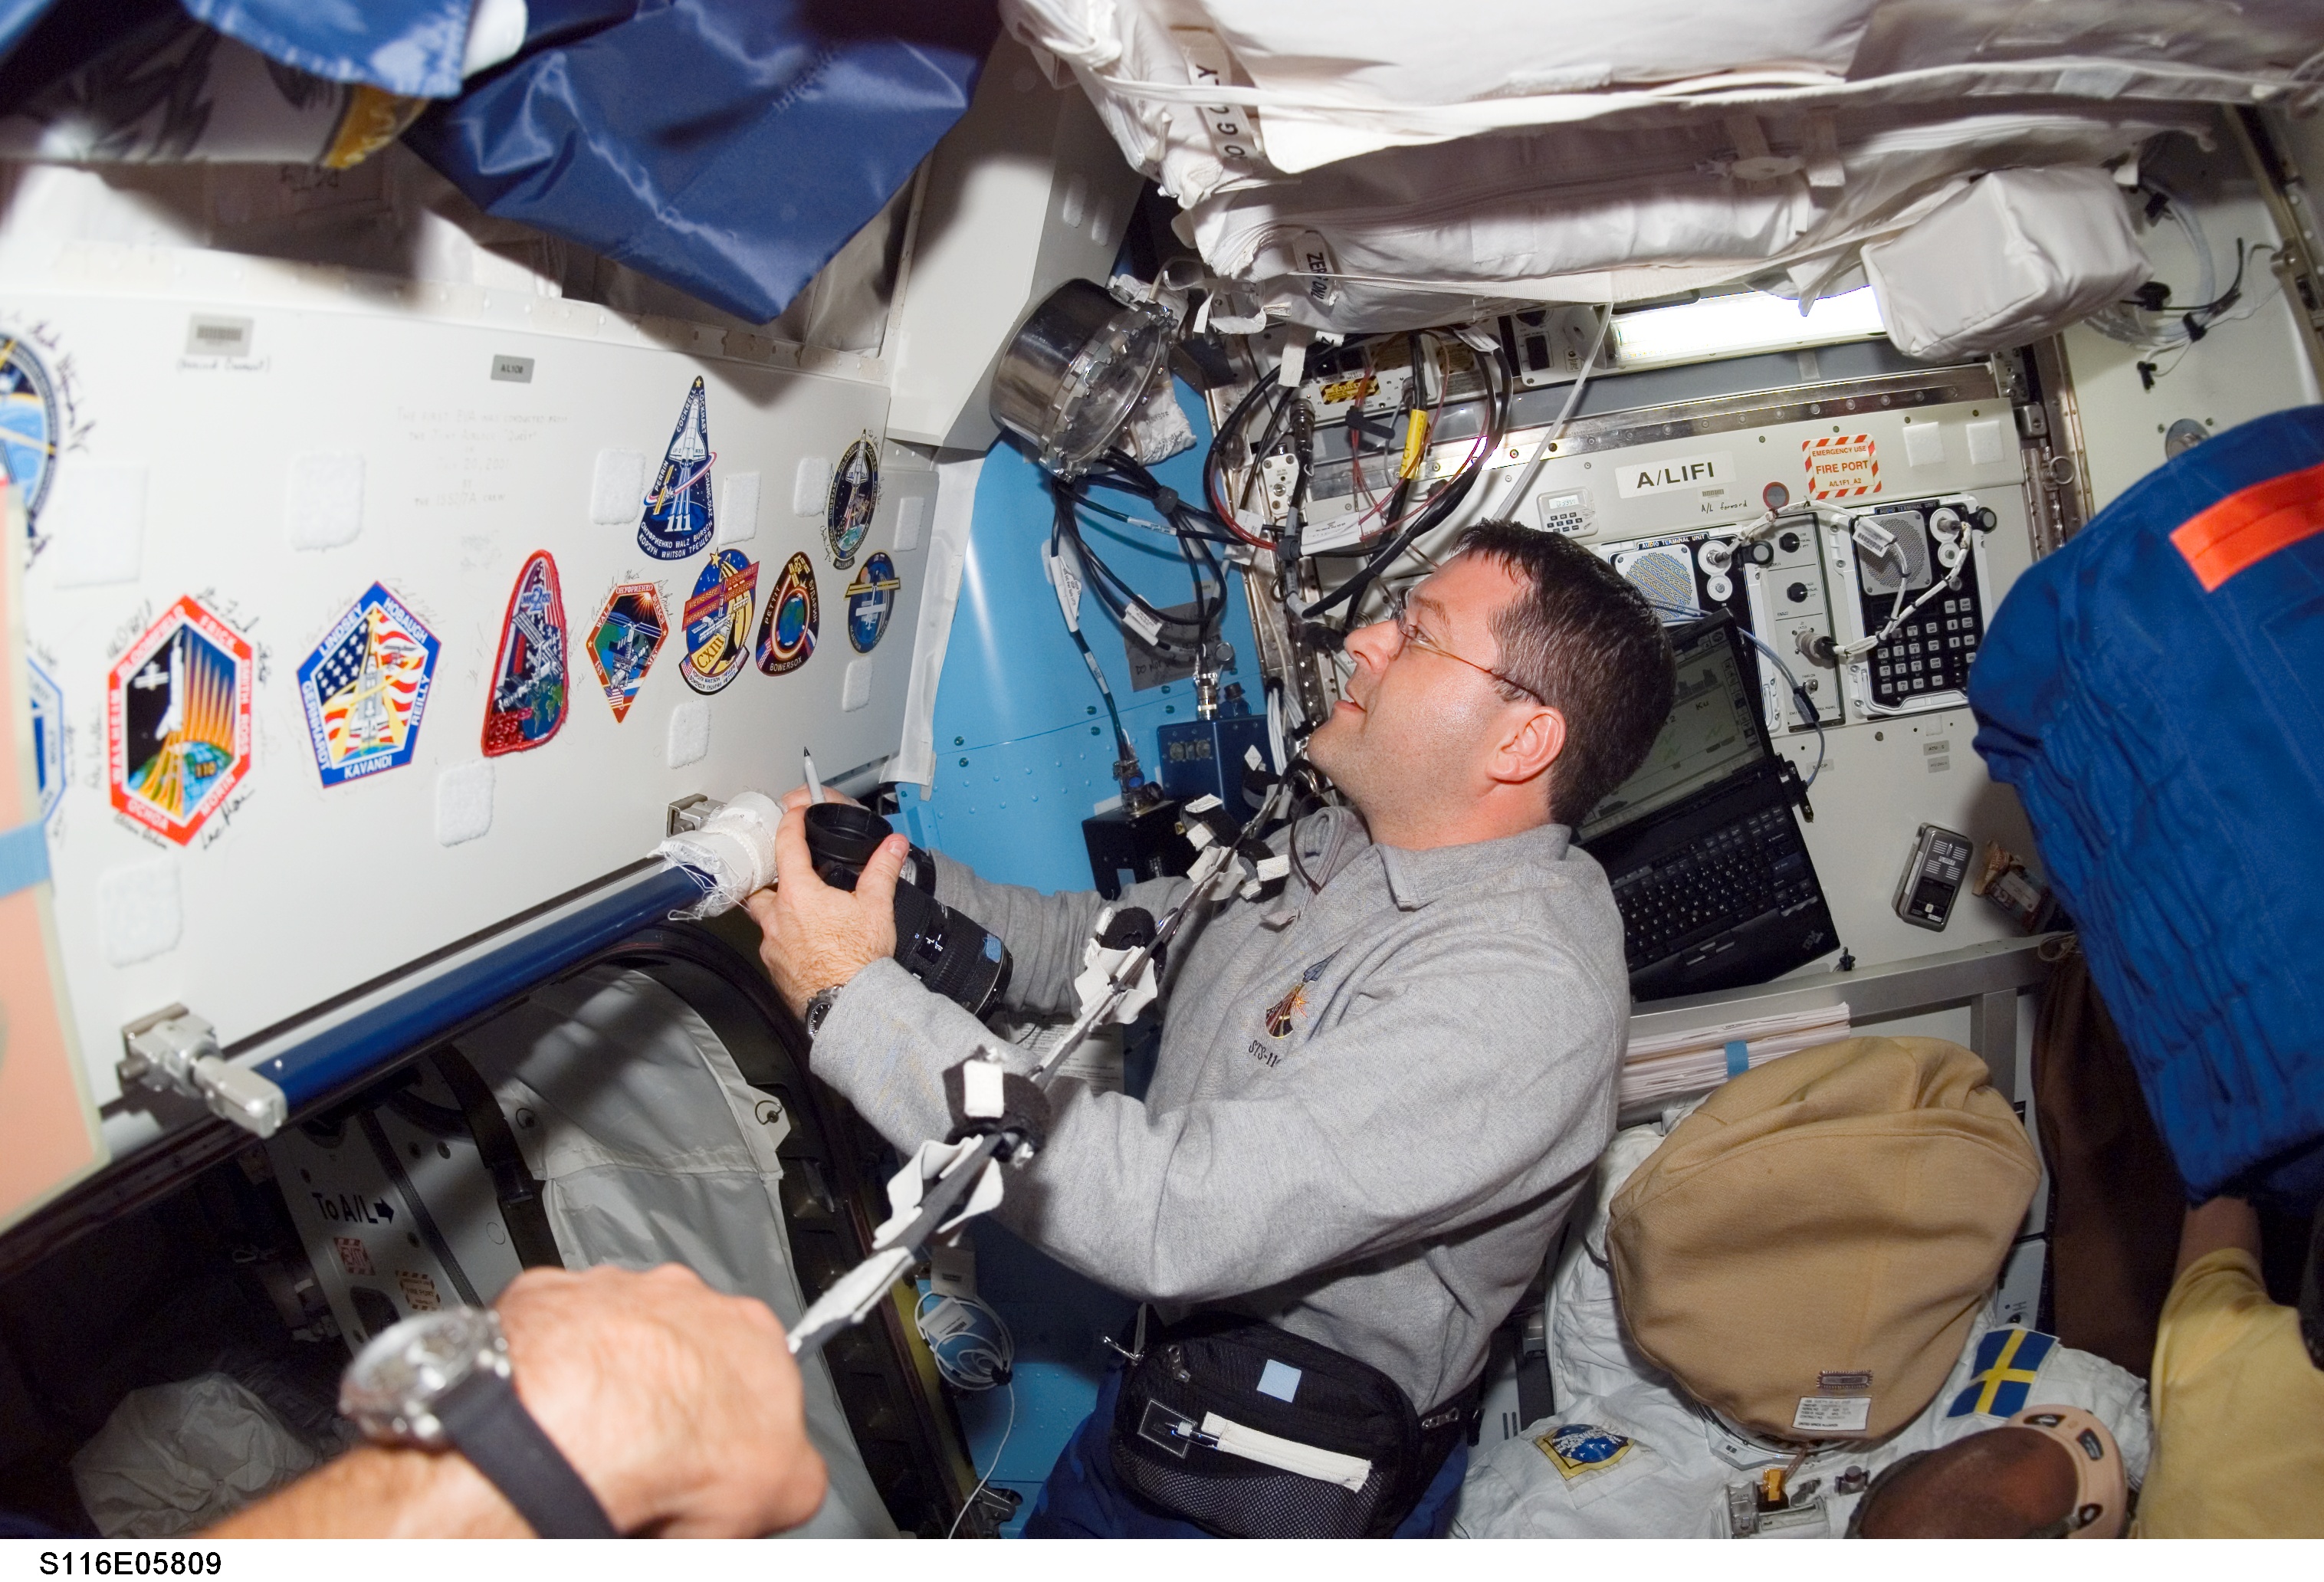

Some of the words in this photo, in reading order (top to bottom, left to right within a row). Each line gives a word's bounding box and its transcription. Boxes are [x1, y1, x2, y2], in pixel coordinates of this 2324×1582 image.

[676, 389, 696, 432] COCKRELL
[1811, 447, 1853, 458] EMERGENCY
[1815, 463, 1840, 474] FIRE
[1841, 460, 1869, 471] PORT
[655, 461, 669, 492] PERRIN
[665, 514, 691, 533] 111
[675, 538, 690, 548] WALZ
[693, 522, 713, 542] BURSCH
[661, 550, 686, 559] WHITSON
[1642, 540, 1659, 549] AUDIO
[1661, 537, 1689, 545] TERMINAL
[383, 597, 428, 644] HOBAUGH
[596, 603, 612, 629] WALZ
[652, 594, 665, 625] BURSCH
[765, 585, 780, 625] PETTIT
[117, 605, 186, 677] BLOOMFIELD
[199, 615, 238, 651] FRICK
[318, 602, 363, 658] LINDSEY
[697, 637, 725, 668] CXIII
[770, 655, 803, 671] BOWERSOX
[241, 658, 251, 705] SMITH
[594, 661, 604, 676] ISS
[410, 674, 431, 726] REILLY
[1695, 701, 1709, 711] Ku
[240, 713, 250, 756] ROSS
[302, 680, 329, 770] GERNHARDT
[344, 755, 392, 780] KAVANDI
[200, 773, 237, 818] MORIN
[127, 799, 170, 832] OCHOA
[1249, 1040, 1282, 1068] STS-11
[312, 1192, 339, 1220] To
[339, 1193, 379, 1224] A/L
[341, 1246, 367, 1267] EXIT
